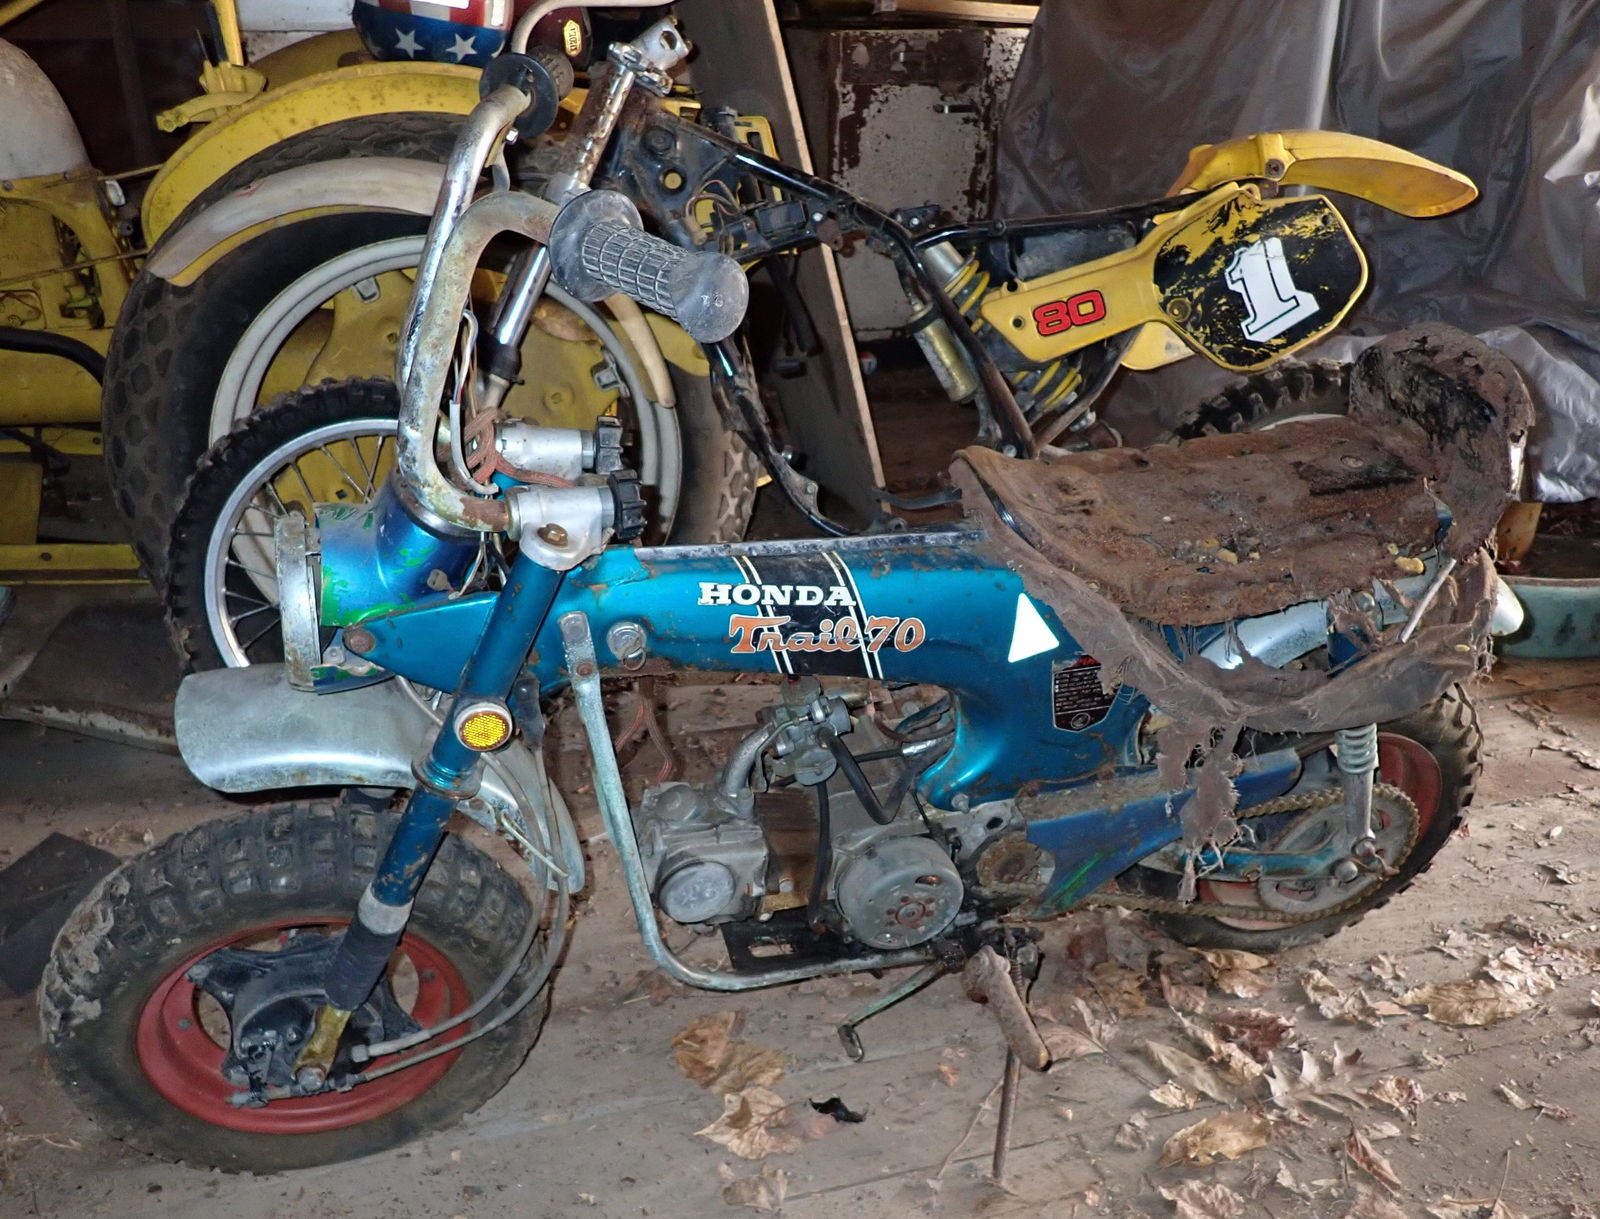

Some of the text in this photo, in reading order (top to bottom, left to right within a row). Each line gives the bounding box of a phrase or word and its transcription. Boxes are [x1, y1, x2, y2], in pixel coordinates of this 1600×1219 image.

[1224, 237, 1320, 342] 1
[1033, 290, 1106, 337] 80
[698, 582, 856, 606] HONDA
[729, 614, 926, 653] Trail 70
